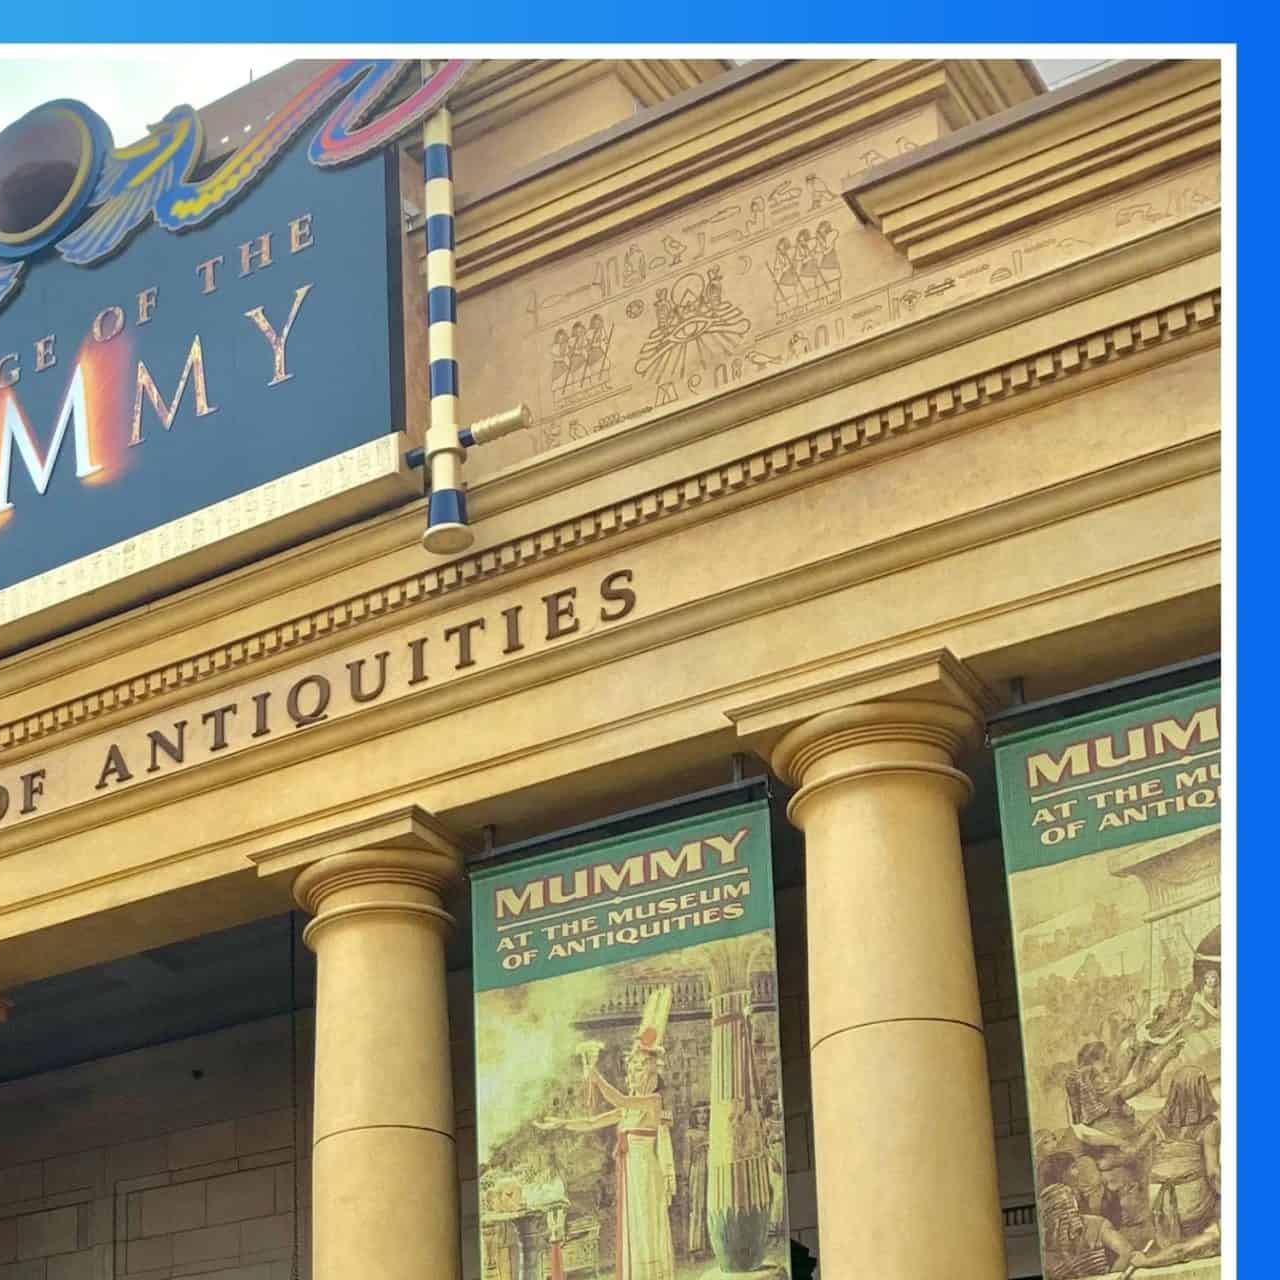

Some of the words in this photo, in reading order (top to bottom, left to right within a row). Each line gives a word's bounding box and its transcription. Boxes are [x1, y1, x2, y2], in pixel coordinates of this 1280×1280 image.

[92, 286, 159, 343] OF
[195, 213, 315, 296] THE
[94, 568, 637, 790] ANTIQUITIES
[1031, 800, 1078, 827] AT
[1088, 779, 1164, 809] THE
[1040, 819, 1087, 846] OF
[1098, 785, 1221, 831] ANTIQ
[495, 828, 749, 918] MUMMY
[496, 931, 533, 952] AT
[541, 916, 598, 940] THE
[608, 880, 751, 926] MUSEUM
[501, 949, 538, 970] OF
[548, 903, 745, 960] ANTIQUITIES
